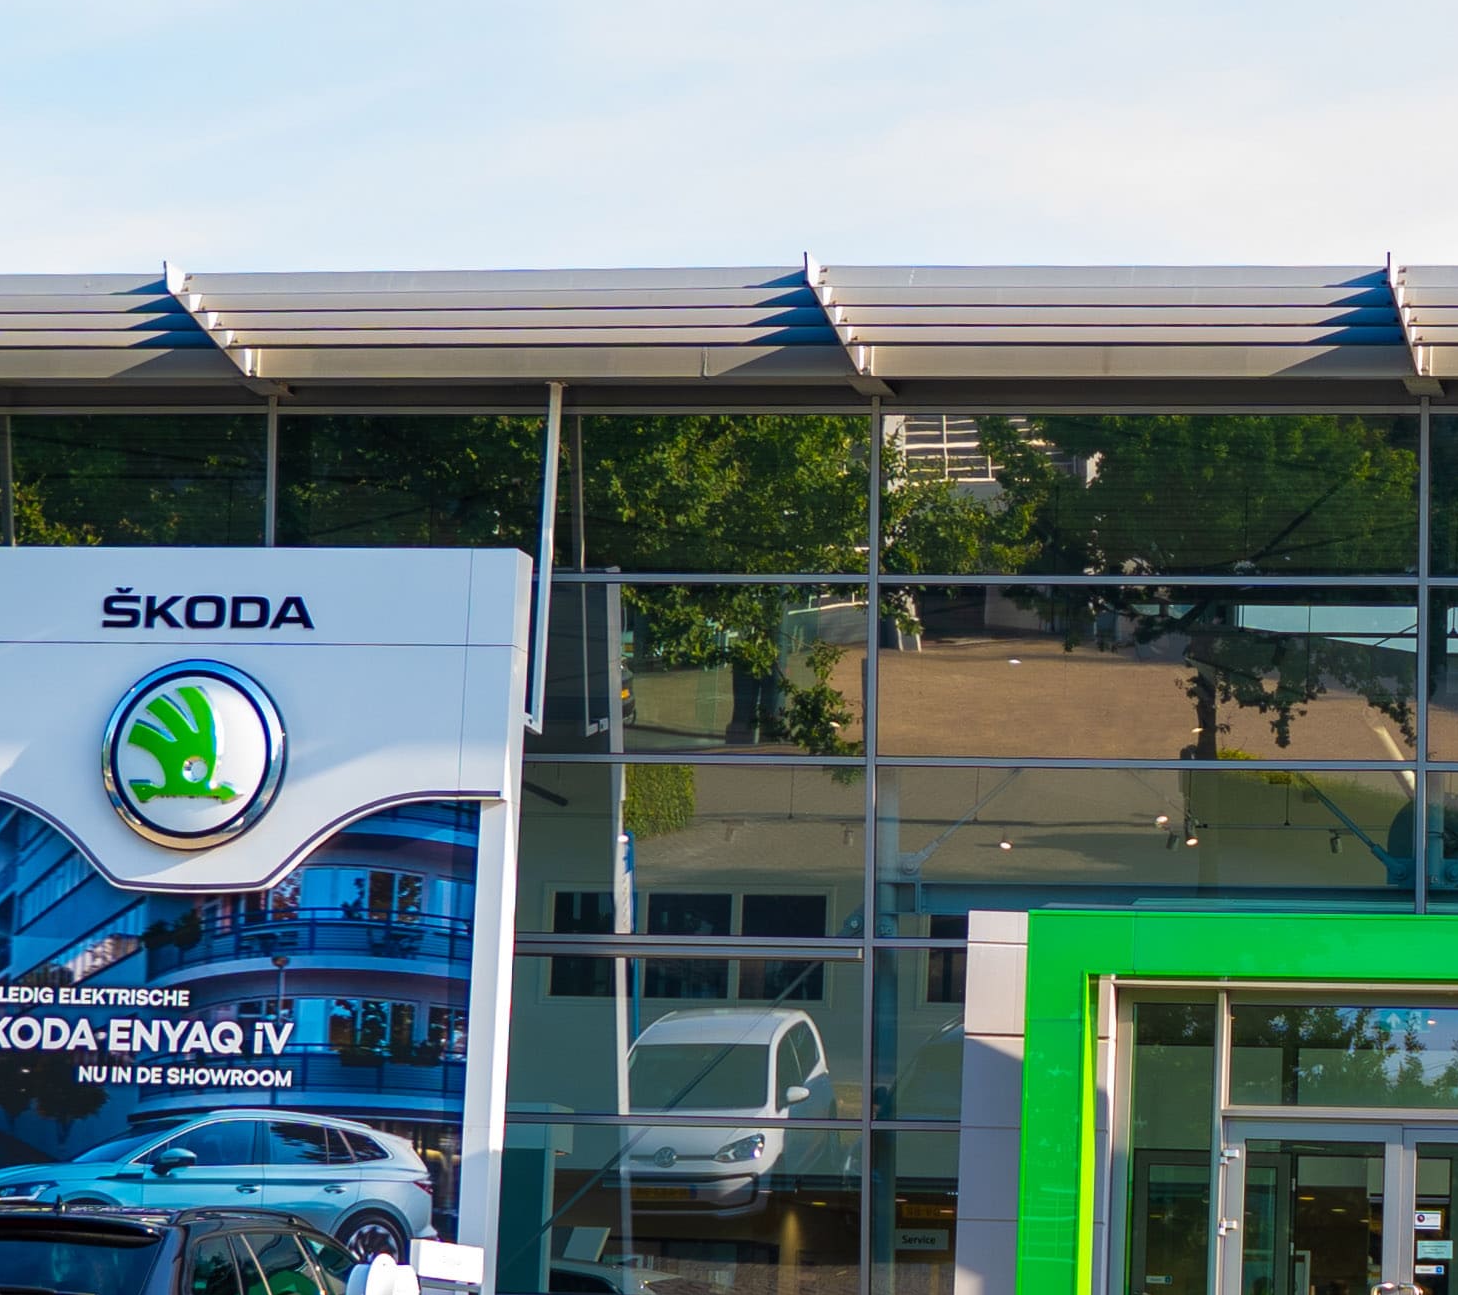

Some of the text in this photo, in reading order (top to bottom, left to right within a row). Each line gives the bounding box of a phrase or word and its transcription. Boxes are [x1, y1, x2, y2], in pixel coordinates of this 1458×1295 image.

[101, 587, 314, 629] ŠKODA
[58, 987, 190, 1007] ELEKTRISCHE
[108, 1019, 243, 1054] ENYAQ
[253, 1021, 294, 1055] iV
[78, 1066, 292, 1088] NU IN DE SHOWROOM
[902, 1235, 936, 1244] Service
